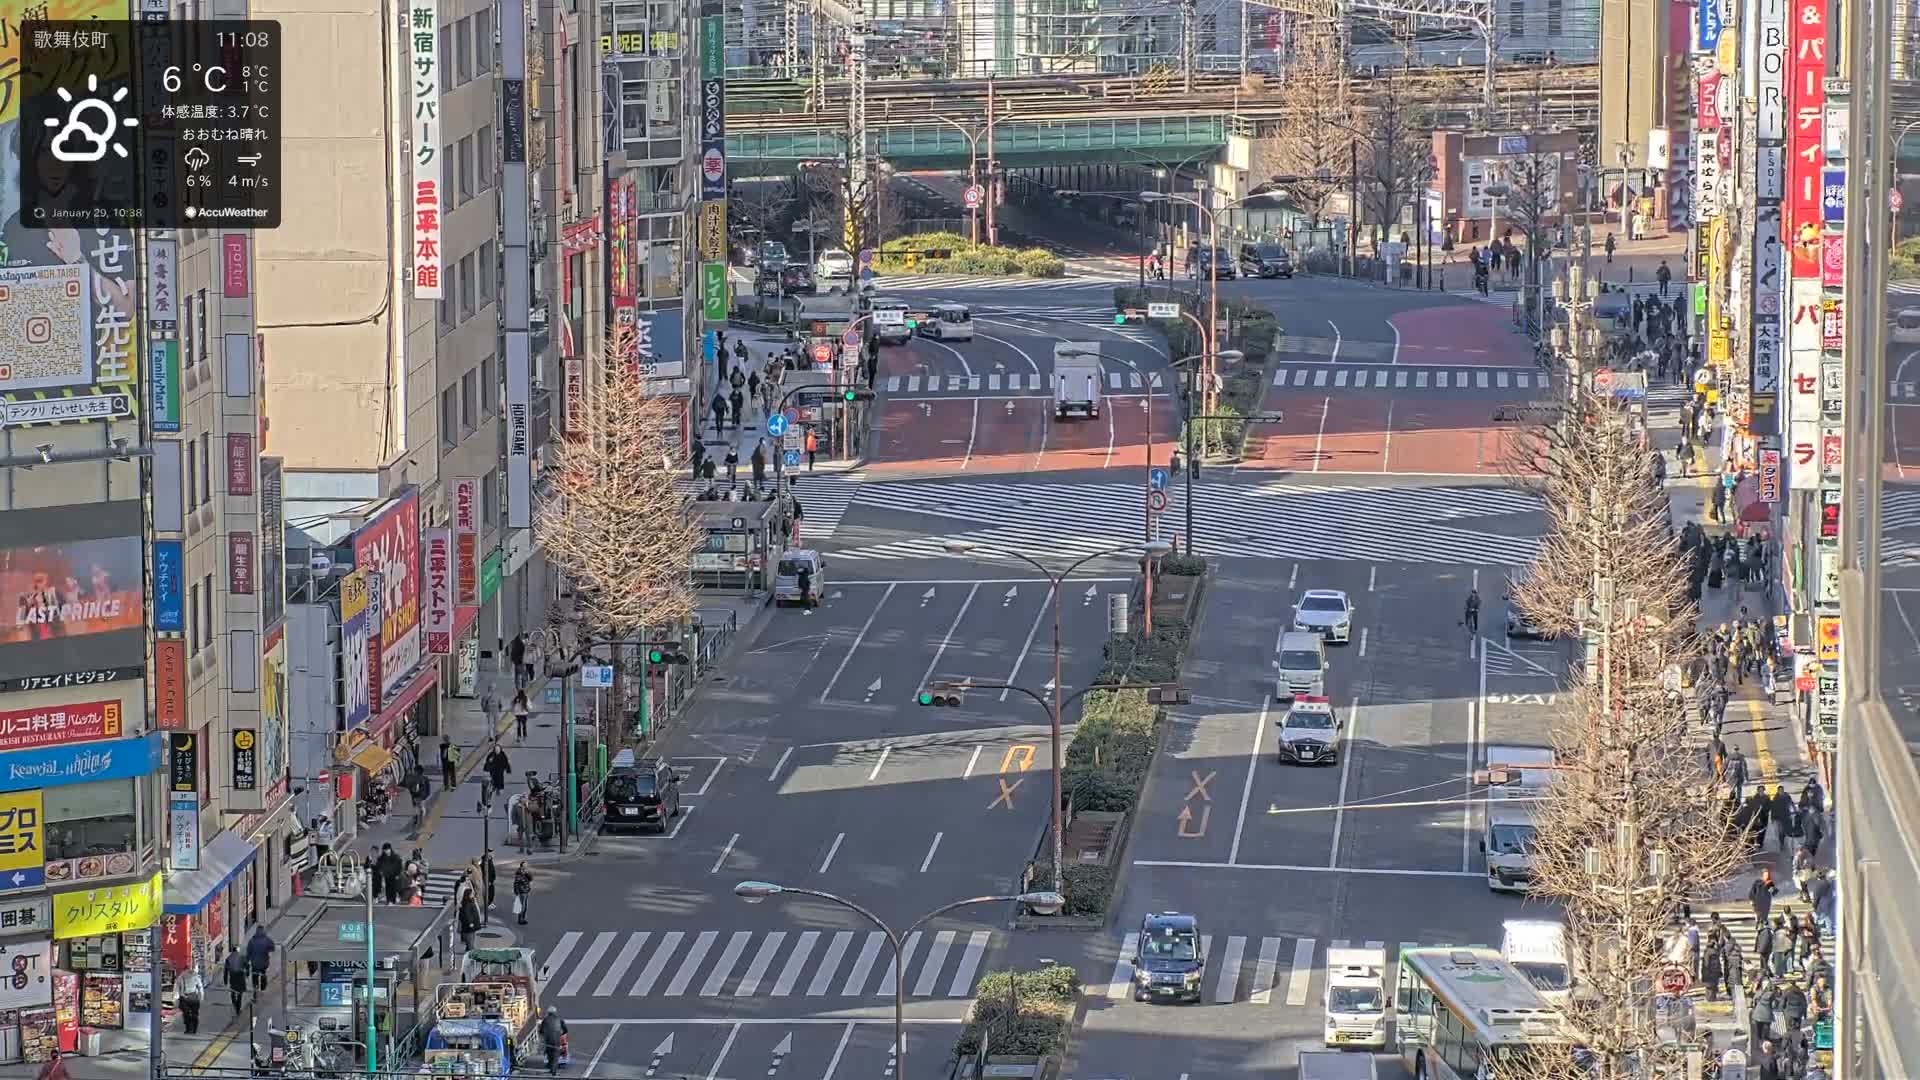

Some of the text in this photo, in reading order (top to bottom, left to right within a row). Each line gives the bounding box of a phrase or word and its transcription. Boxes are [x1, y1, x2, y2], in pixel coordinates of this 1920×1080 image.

[1703, 84, 1715, 117] アコム
[412, 7, 438, 288] 新宿サンパーク 三平本館
[708, 271, 721, 310] レイク
[154, 349, 167, 411] FamilyMart
[1793, 304, 1819, 465] パセラ
[430, 538, 446, 626] 三平ストア
[16, 604, 53, 626] LAST
[21, 670, 117, 691] リアエイドビジョン
[22, 731, 66, 745] RESTAURANT
[1, 909, 36, 929] 囲碁
[67, 899, 139, 924] クリスタル
[325, 988, 340, 1000] 12
